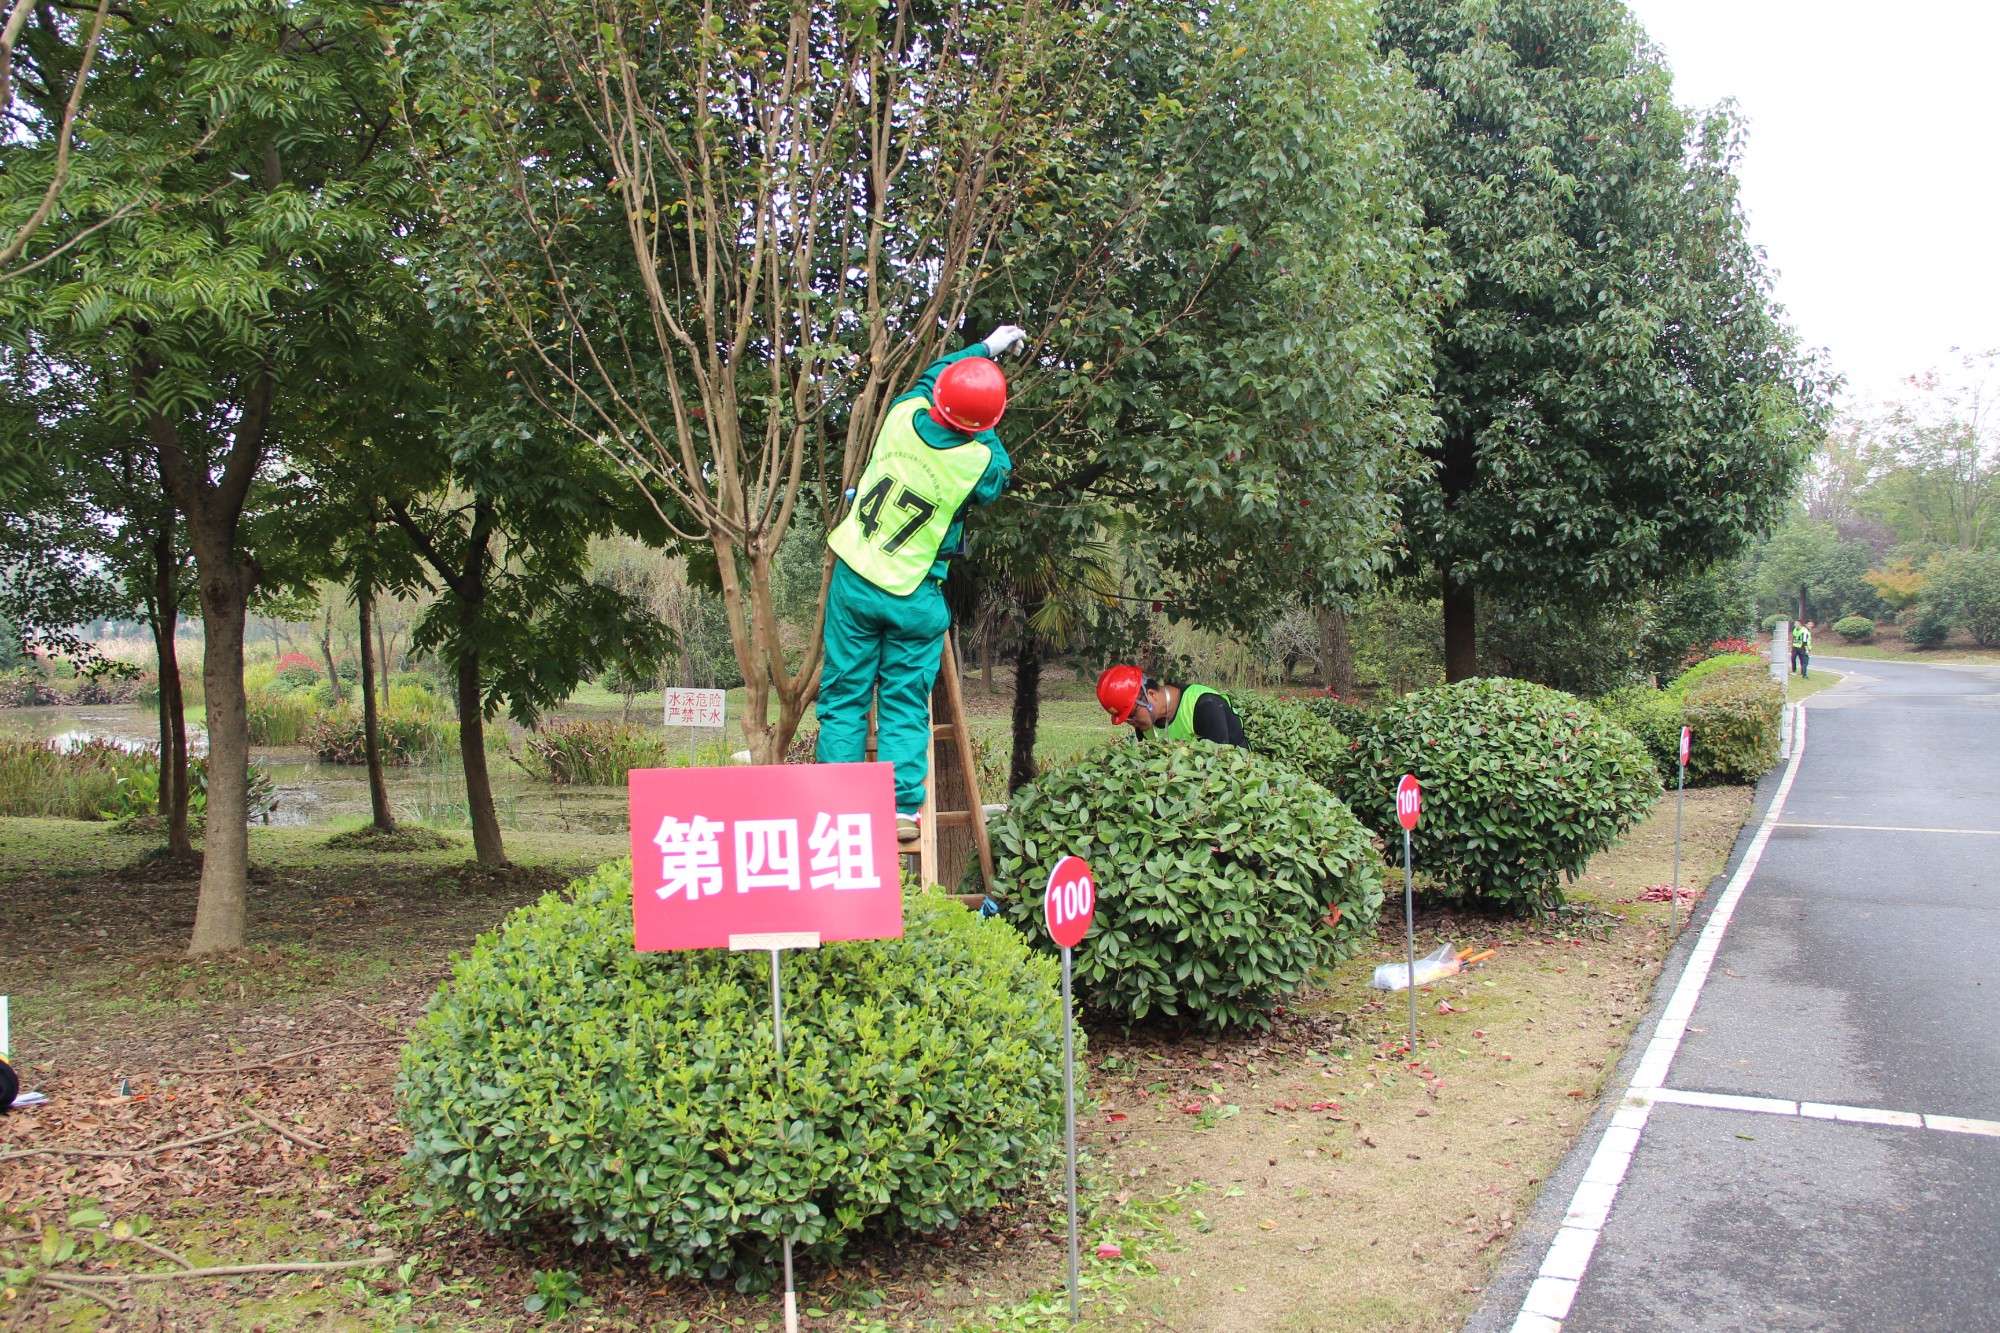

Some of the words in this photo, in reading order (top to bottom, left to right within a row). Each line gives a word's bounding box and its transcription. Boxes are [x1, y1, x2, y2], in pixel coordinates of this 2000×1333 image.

[857, 474, 939, 557] 47
[668, 691, 722, 707] 水深危险
[668, 707, 721, 723] 严禁下水
[1400, 788, 1418, 815] 101
[653, 811, 881, 900] 第四组
[1052, 876, 1091, 925] 100
